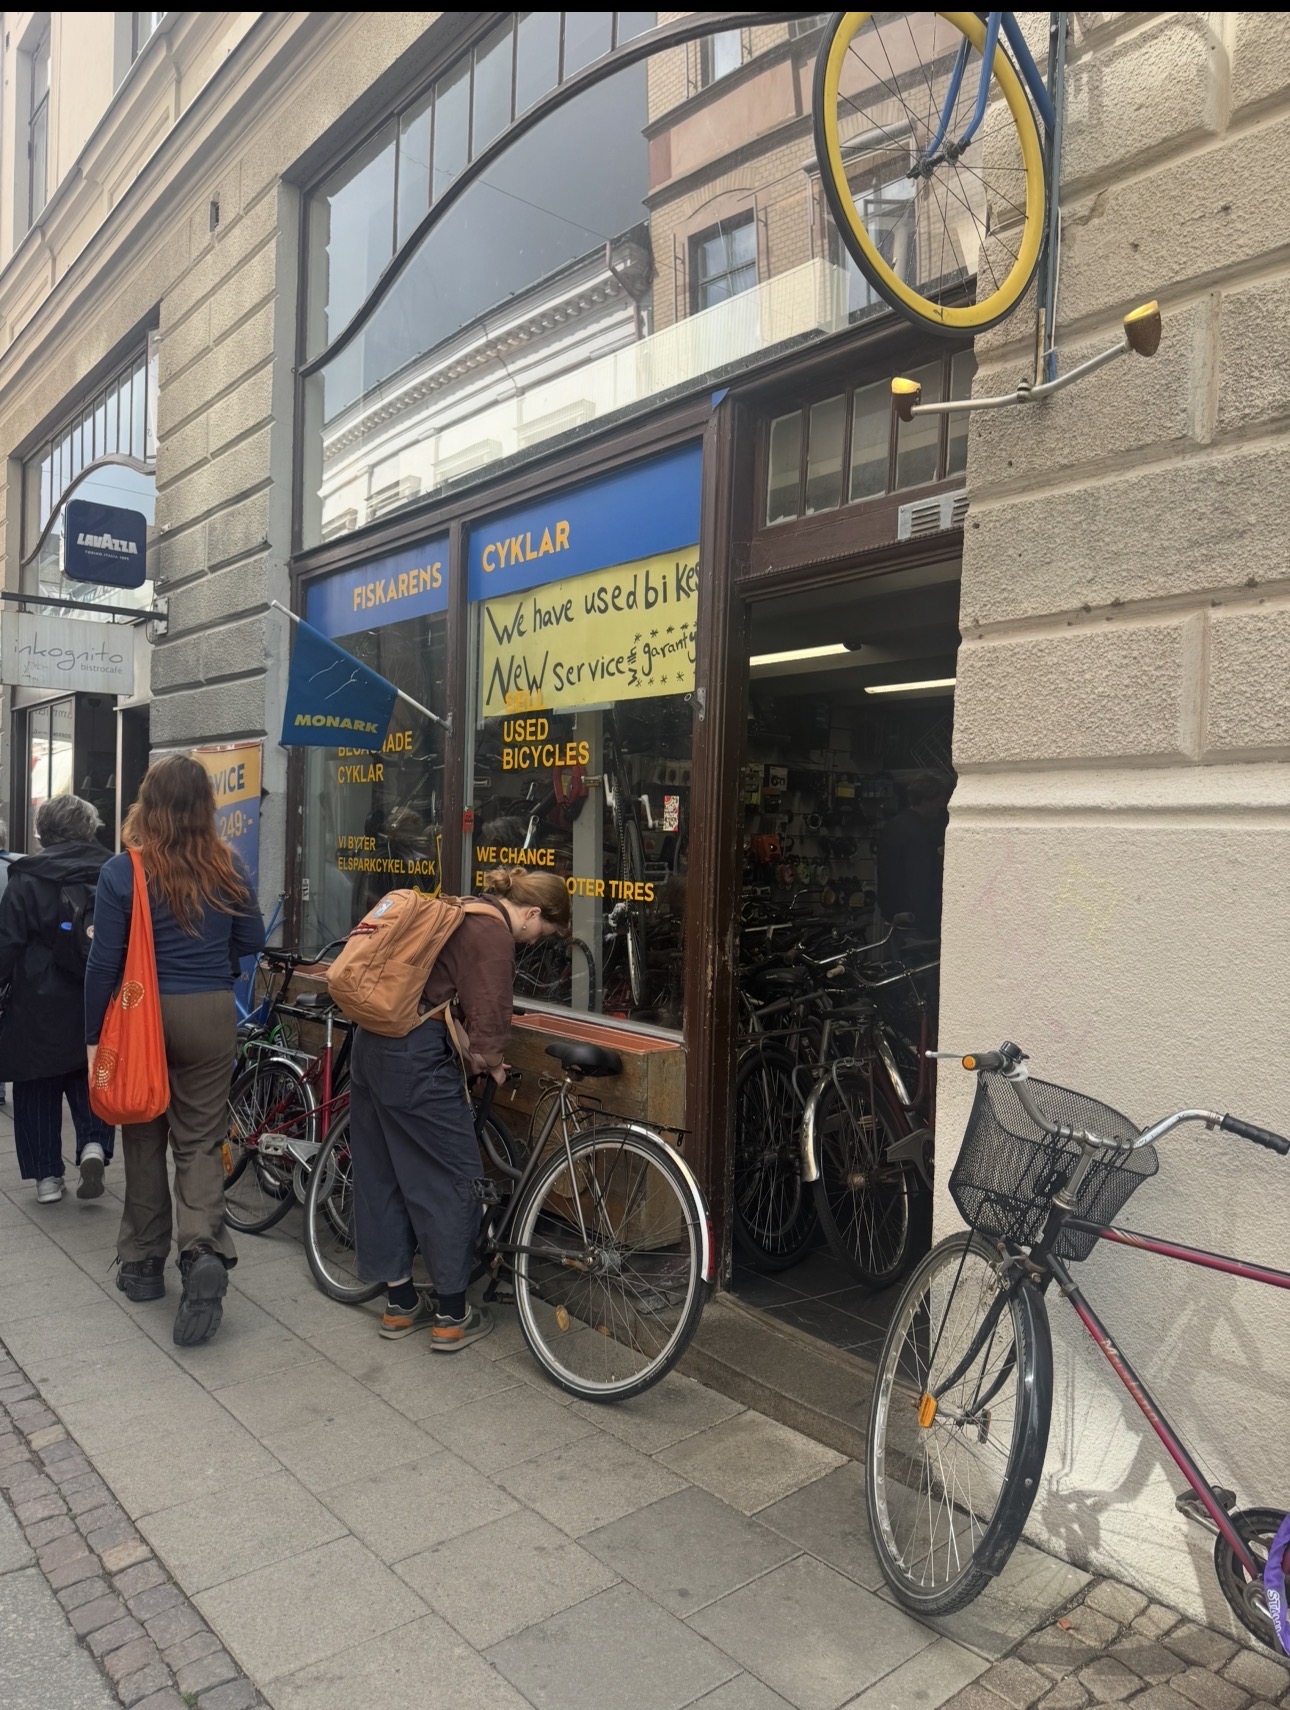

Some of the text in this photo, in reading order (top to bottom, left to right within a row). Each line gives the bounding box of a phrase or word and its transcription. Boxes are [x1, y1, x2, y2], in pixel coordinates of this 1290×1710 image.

[77, 533, 138, 555] LAVAZZA
[482, 520, 570, 573] CYKLAR
[353, 562, 442, 612] FISKARENS
[485, 561, 699, 646] We have used bikes
[14, 631, 123, 671] inkognito
[80, 663, 123, 675] bistrocafé
[504, 689, 545, 714] SELL
[294, 714, 379, 733] MONARK
[503, 718, 549, 743] USED
[502, 741, 590, 770] BICYCLES
[208, 763, 245, 796] VICE
[337, 763, 384, 784] CYKLAR
[338, 836, 376, 851] VI BYTER
[337, 857, 435, 876] ELSPARKCYKEL DÄCK
[476, 846, 555, 866] WE CHANGE
[609, 880, 655, 902] TIRES
